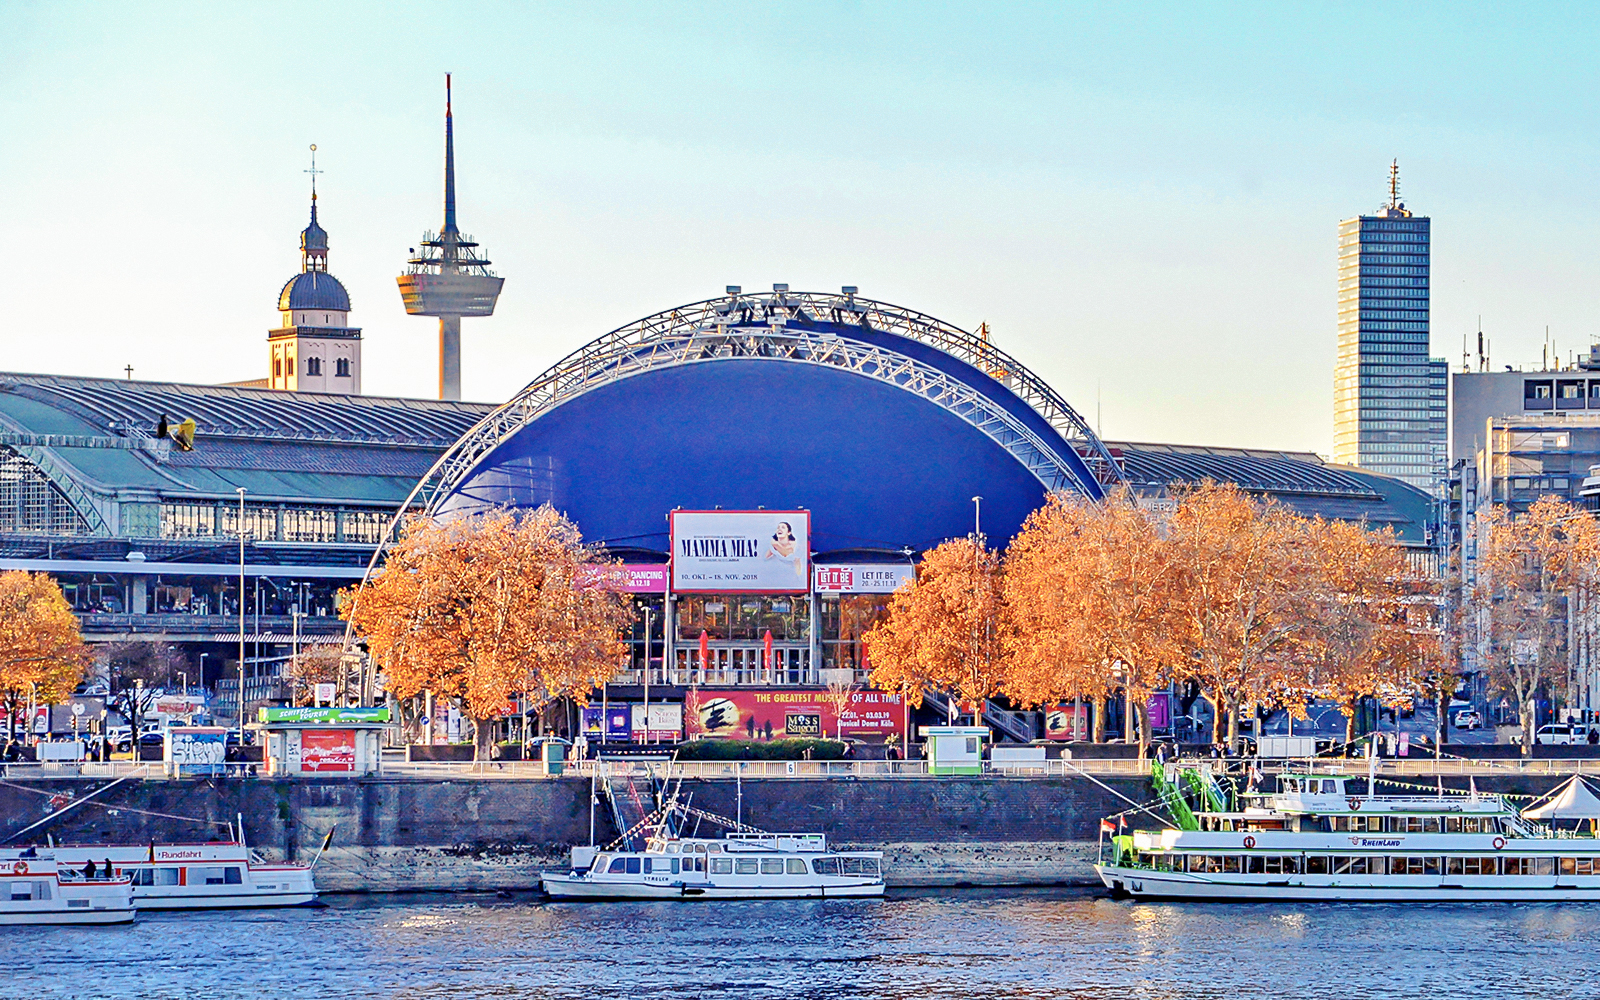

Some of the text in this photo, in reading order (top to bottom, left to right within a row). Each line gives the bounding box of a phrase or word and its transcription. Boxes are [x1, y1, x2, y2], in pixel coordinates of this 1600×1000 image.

[681, 538, 758, 557] MAMMA MIA!
[631, 571, 663, 580] DANCING
[821, 572, 850, 583] LET IT BE
[862, 572, 894, 580] LET IT BE
[773, 693, 812, 703] GREATEST
[852, 693, 863, 703] OF
[865, 693, 879, 703] ALL
[300, 710, 328, 720] TOUREN
[880, 719, 894, 727] Köln
[788, 724, 818, 734] Saigon
[788, 764, 794, 772] 6
